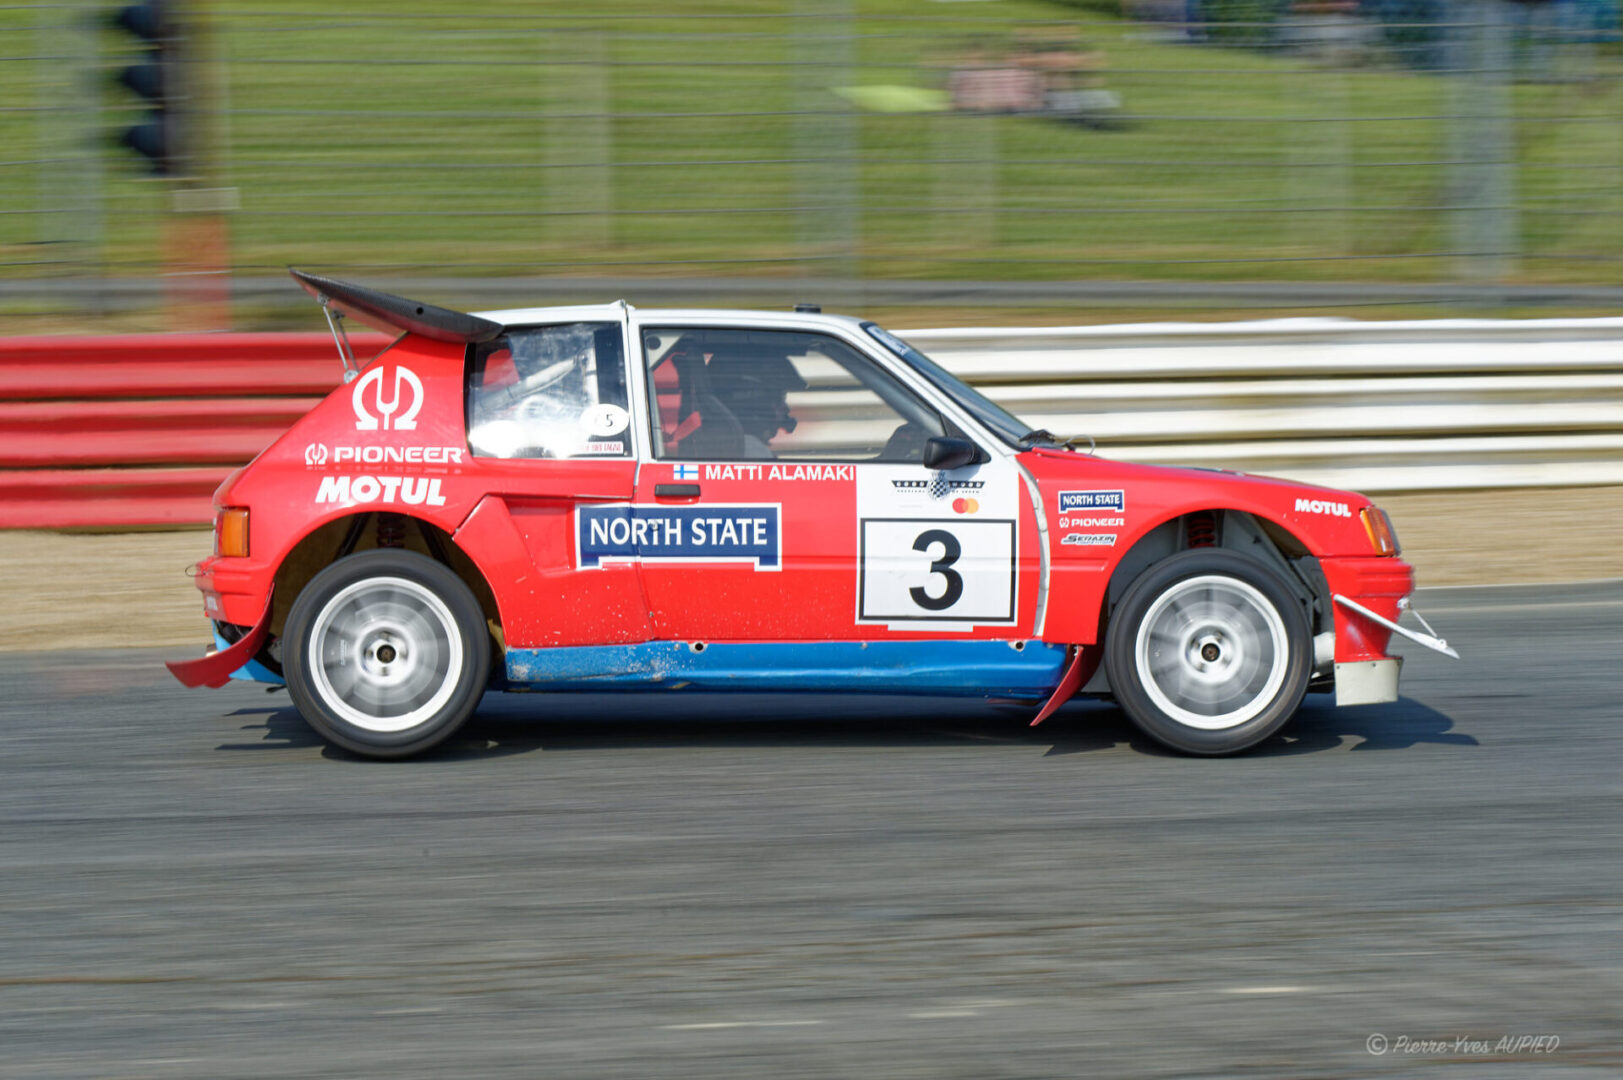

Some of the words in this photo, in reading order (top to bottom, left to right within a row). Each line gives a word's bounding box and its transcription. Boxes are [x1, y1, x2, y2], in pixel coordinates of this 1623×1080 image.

[334, 446, 463, 464] PIONEER
[705, 465, 763, 480] MATTI
[768, 465, 855, 481] ALAMAKI
[315, 475, 446, 506] MOTUL
[1063, 495, 1093, 506] NORTH
[1095, 494, 1120, 505] STATE
[1295, 498, 1352, 518] MOTUL
[590, 518, 682, 546] NORTH
[691, 518, 768, 546] STATE
[1071, 518, 1125, 527] PIONEER
[909, 529, 964, 611] 3
